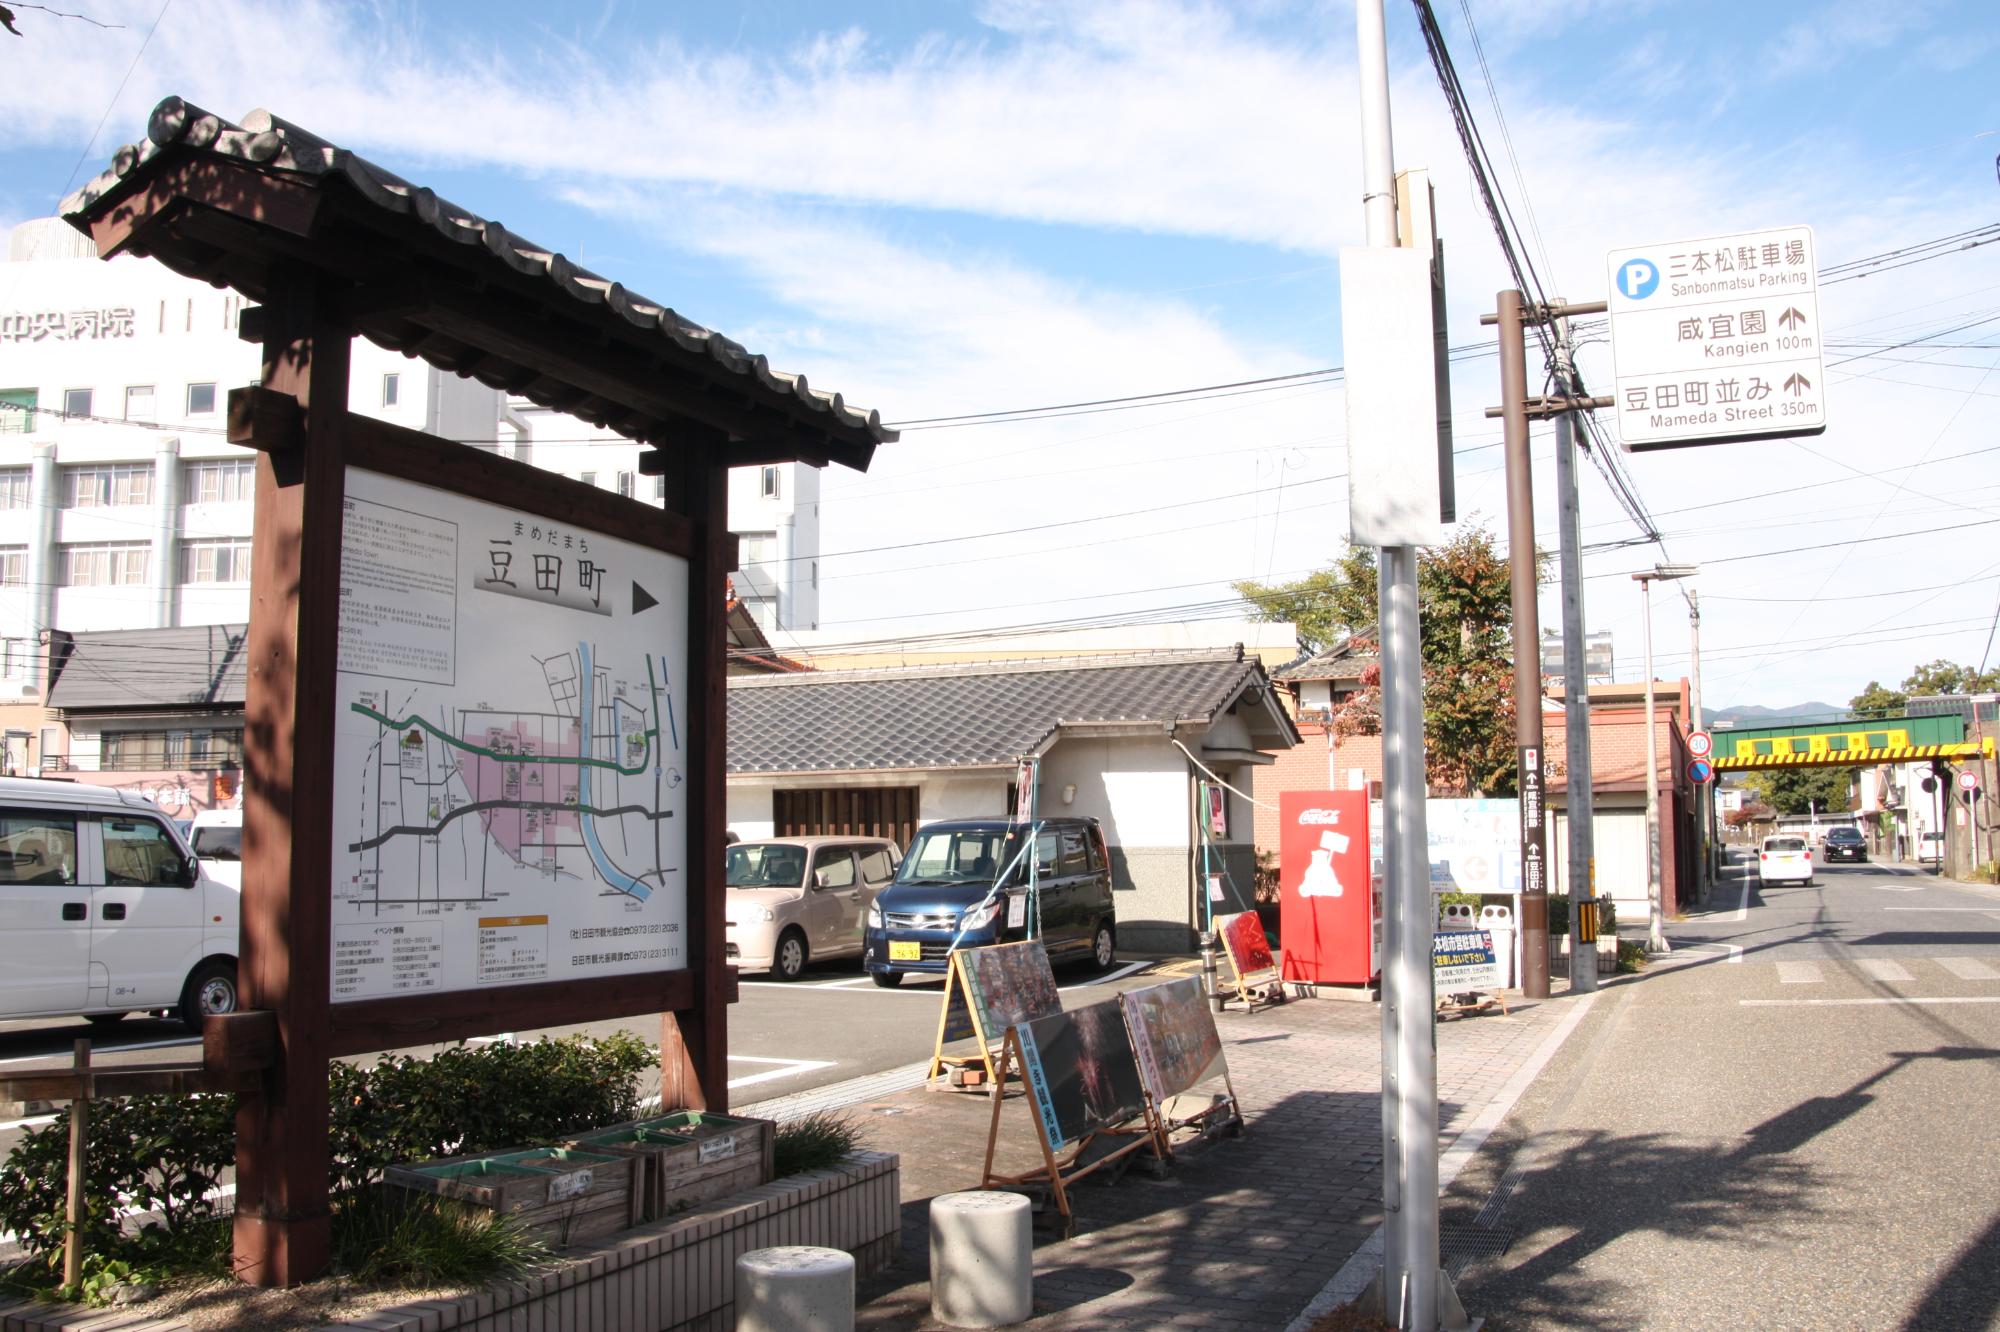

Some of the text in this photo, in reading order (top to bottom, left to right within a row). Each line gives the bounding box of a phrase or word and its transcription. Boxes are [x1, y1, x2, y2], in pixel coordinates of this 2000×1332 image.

[1669, 240, 1805, 278] 三本松駐車場
[1671, 272, 1807, 297] Sanbonmatsu Parking
[1677, 309, 1767, 342] 咸宜園
[1704, 336, 1812, 358] Kangien 100m
[1625, 377, 1772, 412] 豆田町並み
[1650, 401, 1818, 428] Mameda Street 350m
[514, 521, 589, 553] まめだまち
[485, 539, 607, 608] 豆田町
